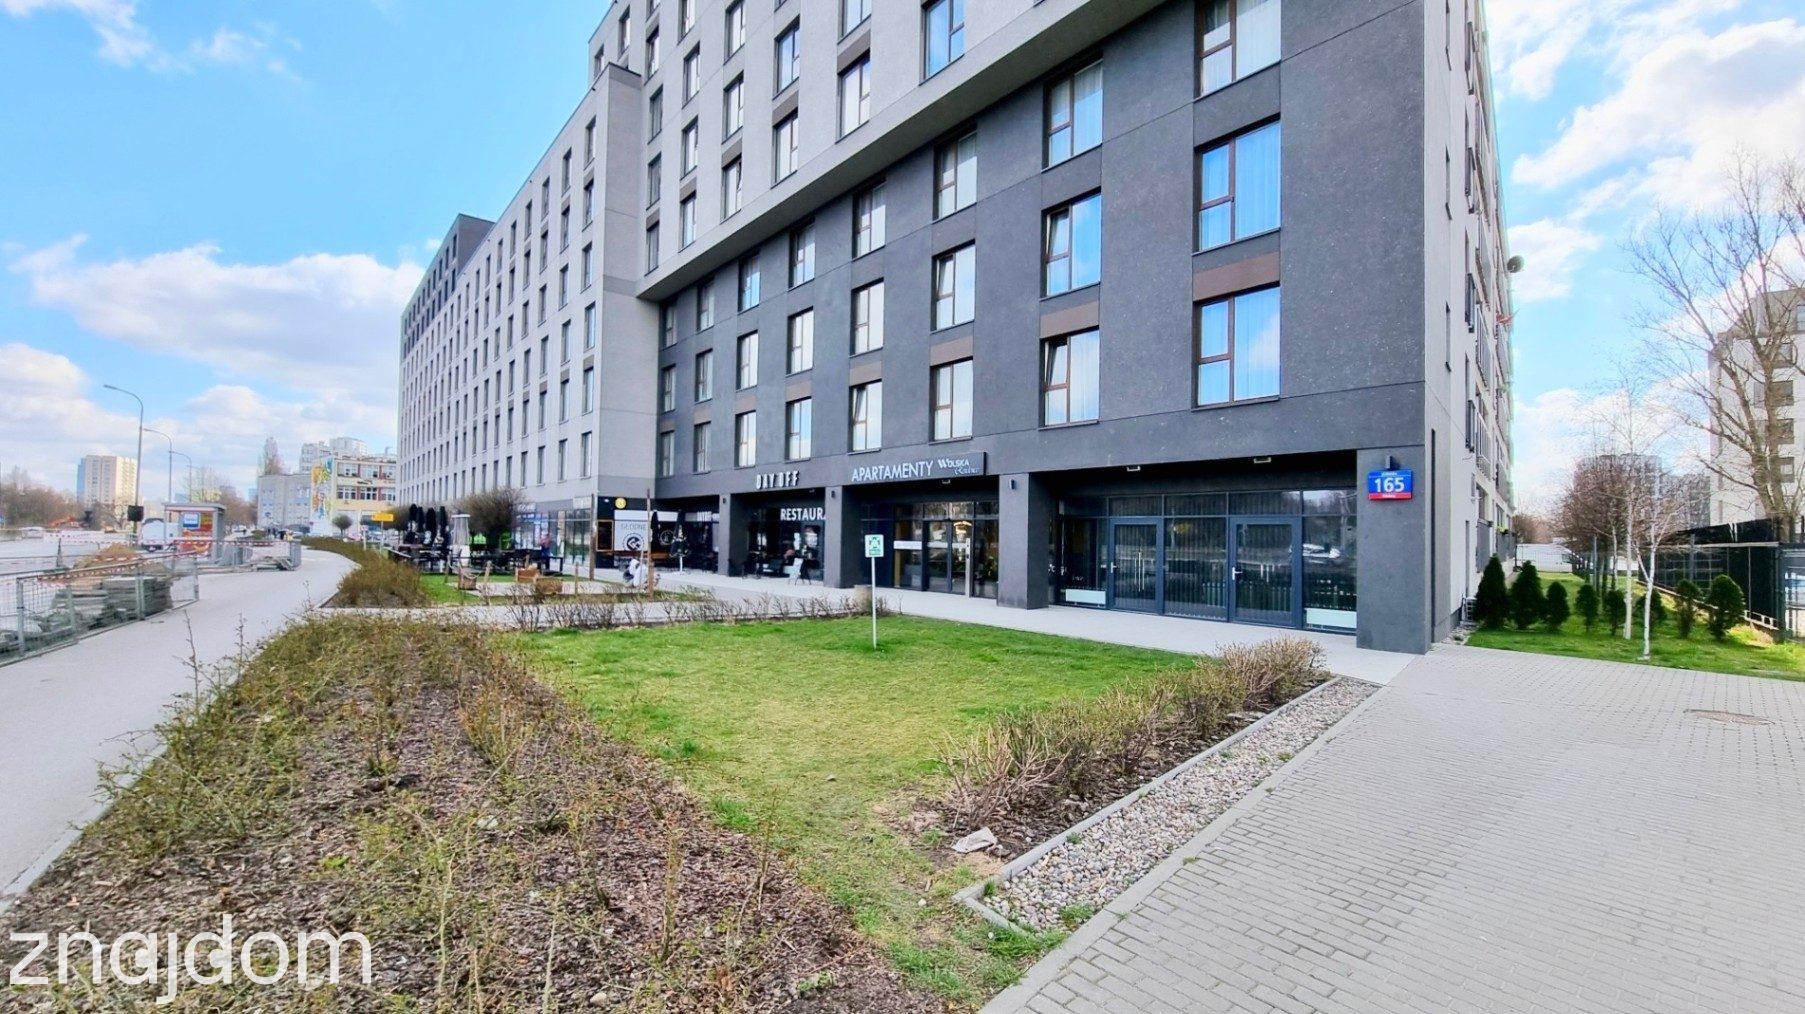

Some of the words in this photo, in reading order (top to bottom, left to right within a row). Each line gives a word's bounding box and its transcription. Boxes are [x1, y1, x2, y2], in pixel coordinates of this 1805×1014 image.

[756, 474, 776, 489] DAY
[779, 470, 799, 487] OFF
[851, 460, 934, 482] APARTAMENTY
[1375, 477, 1405, 493] 165
